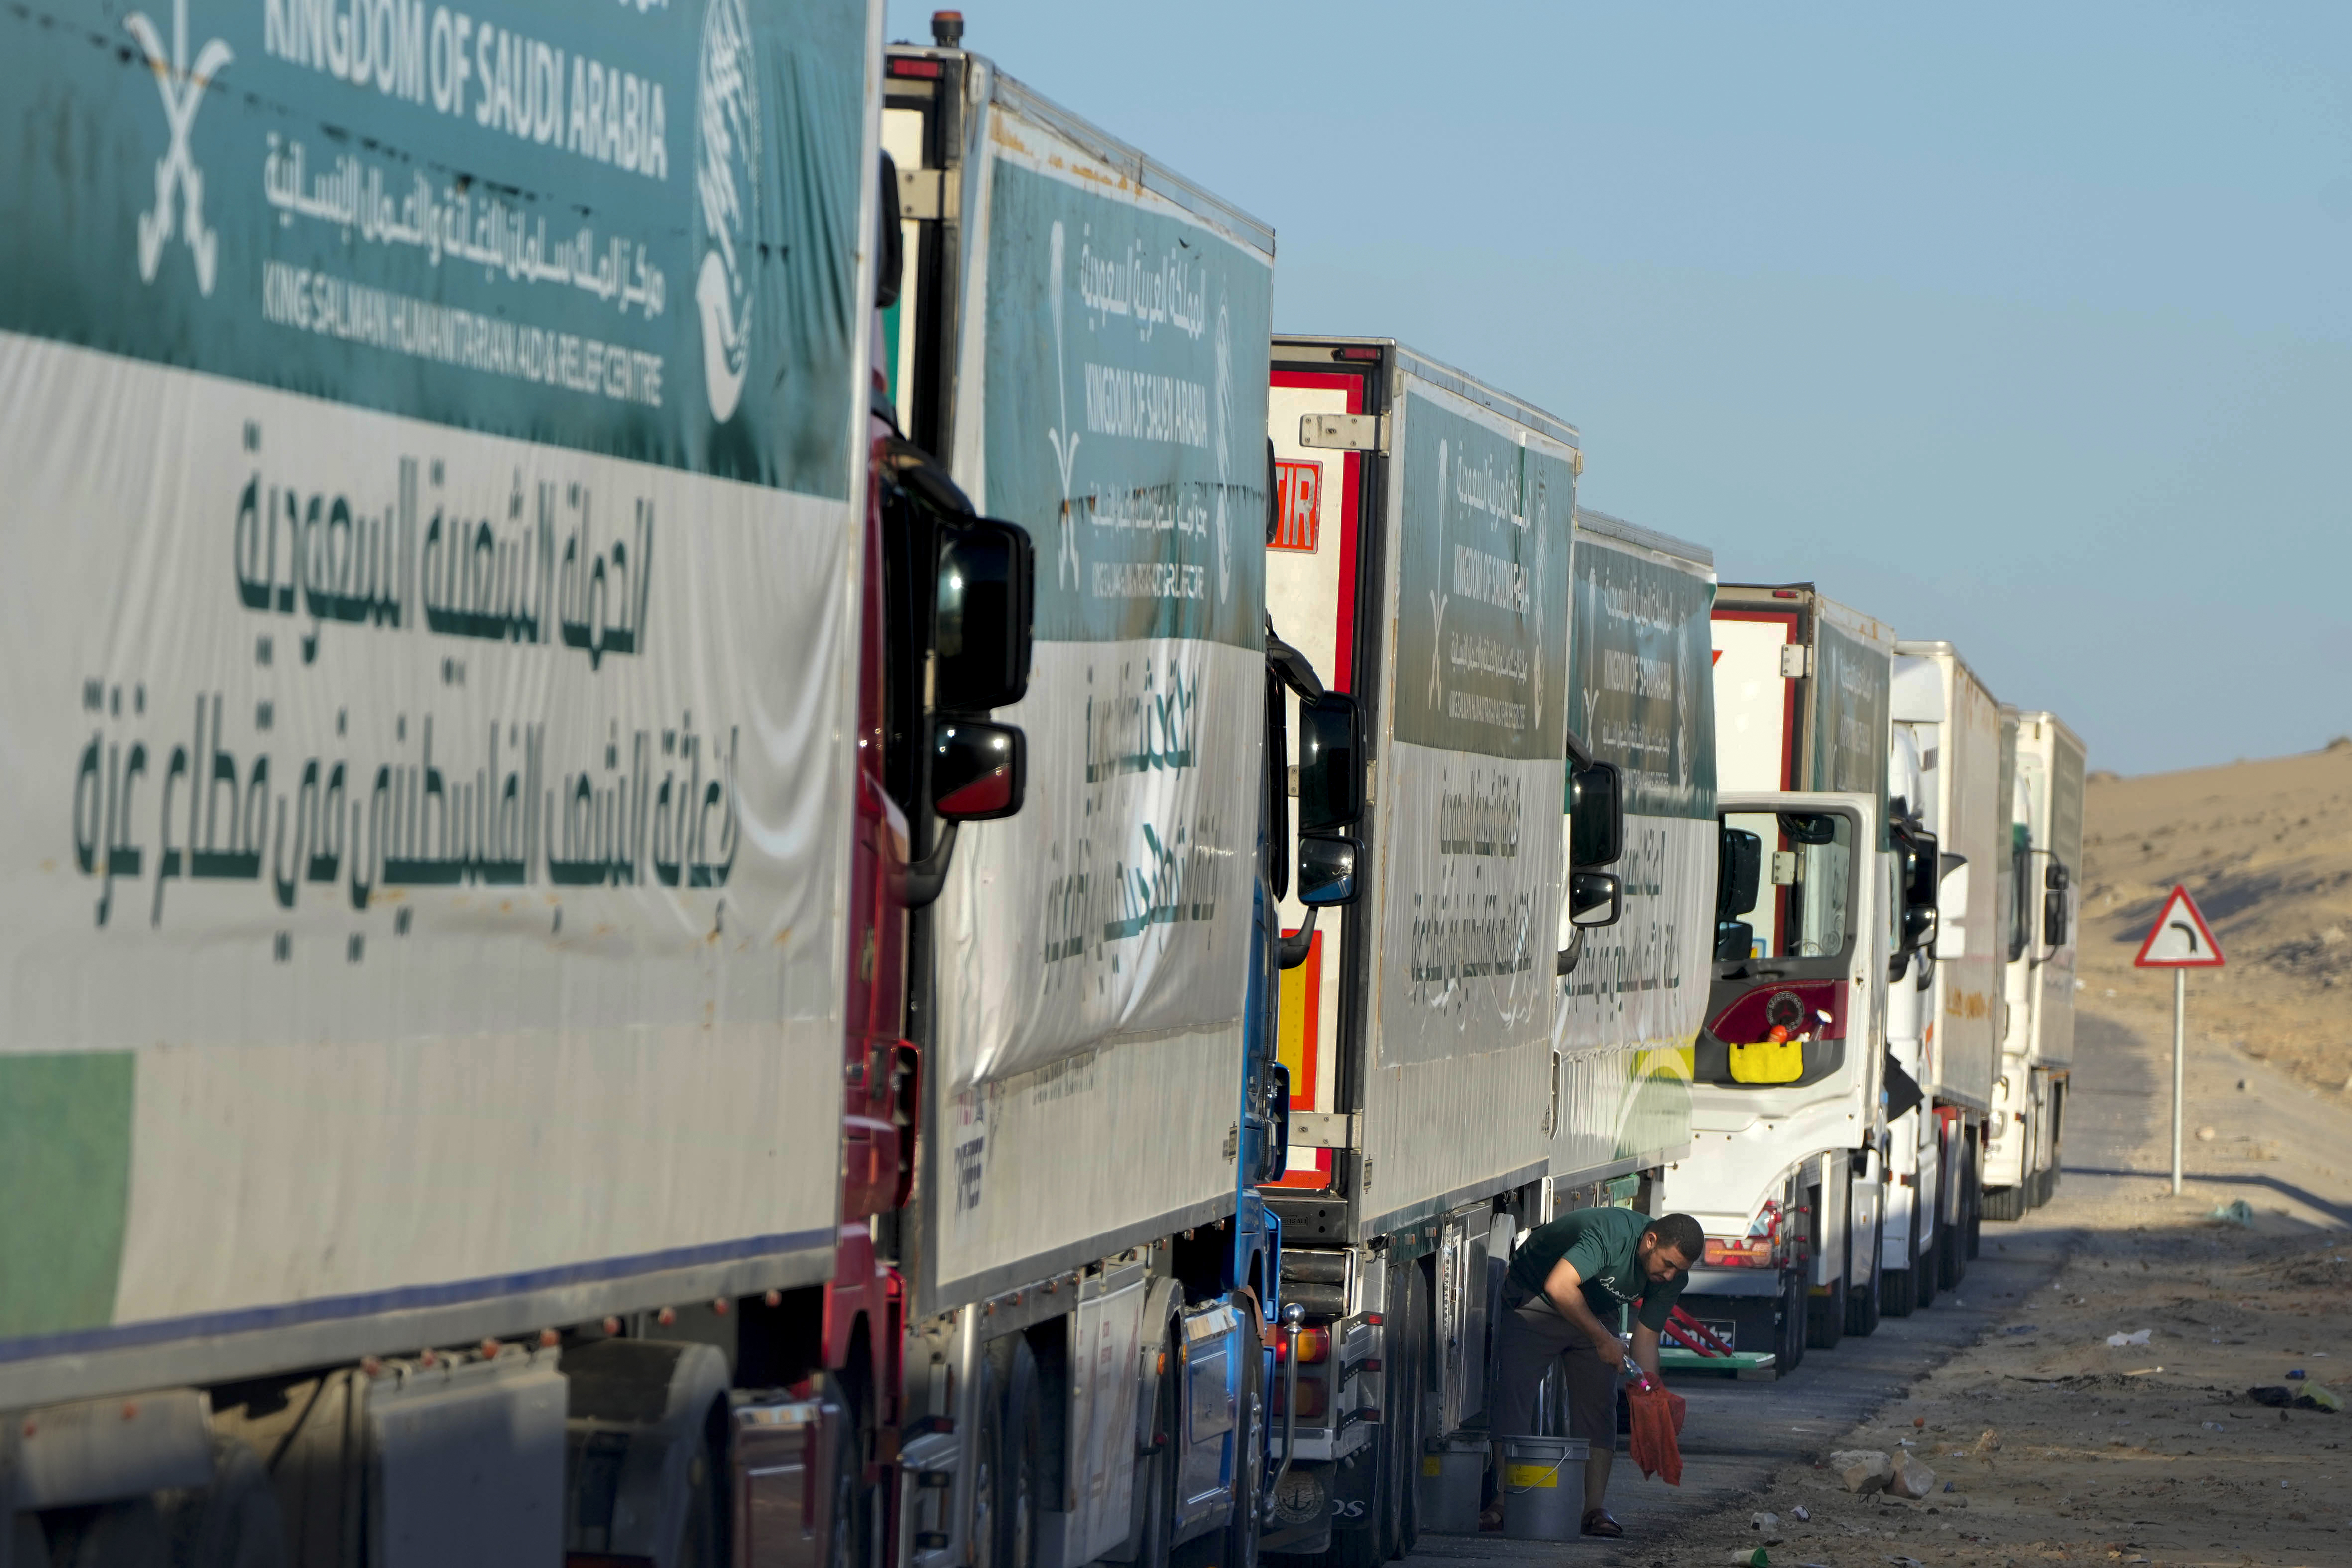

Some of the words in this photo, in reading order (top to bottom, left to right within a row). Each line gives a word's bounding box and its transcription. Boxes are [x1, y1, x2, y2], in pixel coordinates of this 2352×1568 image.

[430, 5, 471, 117] OF
[476, 22, 564, 149] SAUDI
[568, 55, 668, 181] ARABIA
[263, 259, 311, 330] KING
[1081, 222, 1132, 331] السعودية
[1133, 237, 1167, 343] العربية
[1169, 247, 1206, 340] المملكة
[1084, 362, 1133, 437] KINGDOM
[1132, 370, 1145, 439] OF
[1146, 373, 1174, 442] SAUDI
[1175, 378, 1208, 449] ARABIA
[1457, 441, 1488, 521] السعودية
[235, 419, 418, 666] السعودية
[422, 459, 557, 686] الشعبية
[560, 481, 653, 671] الحملة
[1454, 543, 1483, 601] KINGDOM
[1483, 552, 1492, 603] OF
[1491, 556, 1509, 610] SAUDI
[1604, 649, 1630, 693] KINGDOM
[1630, 654, 1638, 695] OF
[73, 676, 147, 930] غزة
